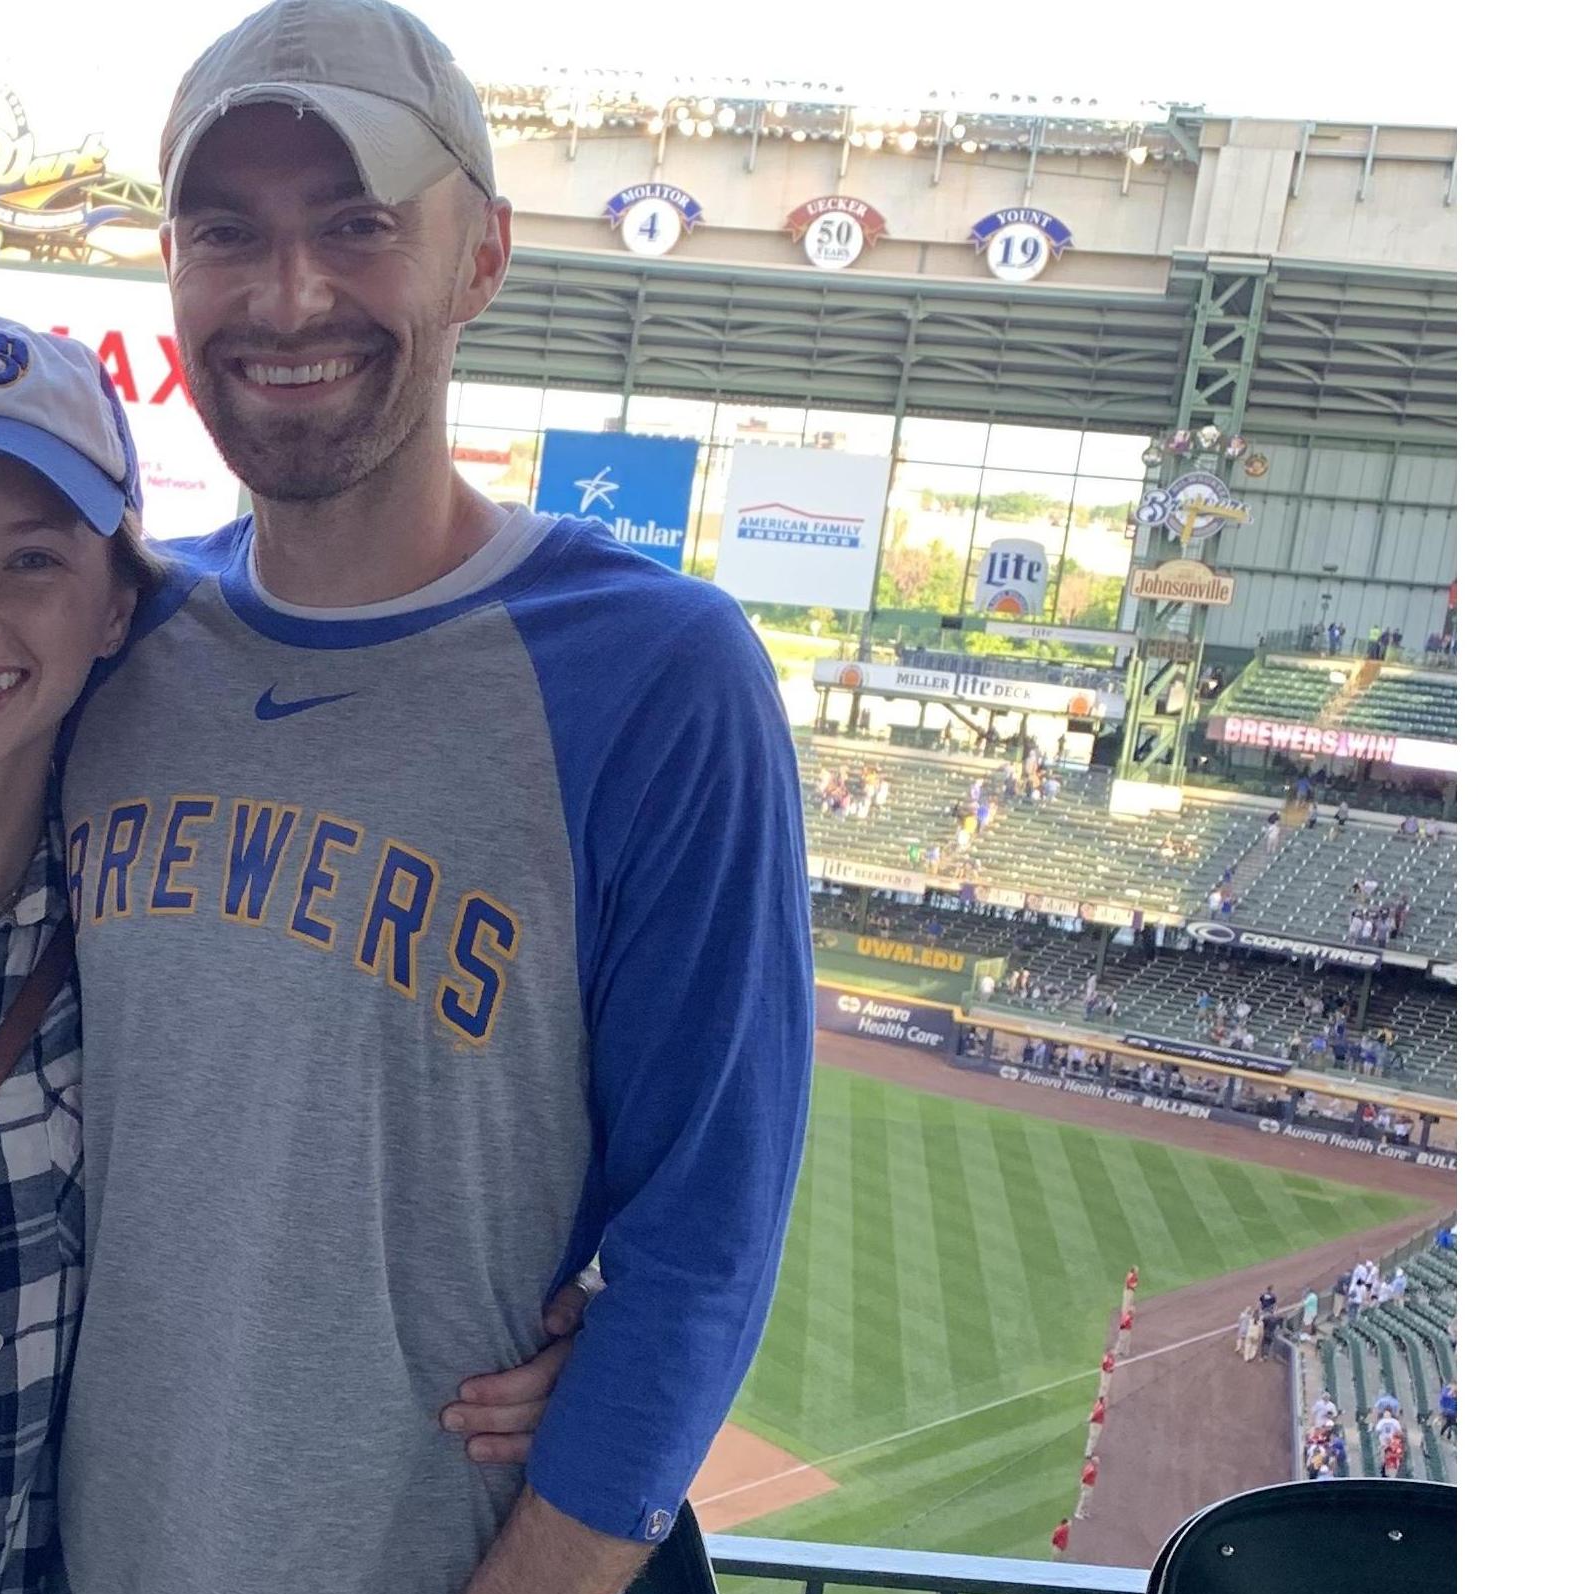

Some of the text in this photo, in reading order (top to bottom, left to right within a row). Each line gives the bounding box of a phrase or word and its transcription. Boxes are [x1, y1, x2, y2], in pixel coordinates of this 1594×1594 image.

[620, 184, 691, 209] MOLITOR
[807, 200, 867, 217] UECKER
[638, 211, 660, 242] 4
[817, 220, 853, 246] 50
[995, 211, 1053, 227] YOUNT
[997, 235, 1041, 270] 19
[587, 515, 684, 547] llular
[739, 516, 862, 537] AMERICAN FAMILY
[744, 529, 854, 548] INSURANCE
[985, 552, 1041, 587] Lite
[1136, 572, 1230, 601] Johnsonville
[896, 672, 950, 690] MILLER
[994, 684, 1032, 700] DECK
[1224, 717, 1395, 761] BREWERS WIN
[857, 936, 965, 973] UWM.EDU
[862, 1000, 911, 1022] Aurora
[858, 1017, 942, 1046] Health Care
[1021, 1068, 1211, 1119] Aurora Health Care BULLPEN
[1283, 1125, 1328, 1144] Aurora
[1330, 1133, 1374, 1153] Health
[1377, 1143, 1407, 1160] Care
